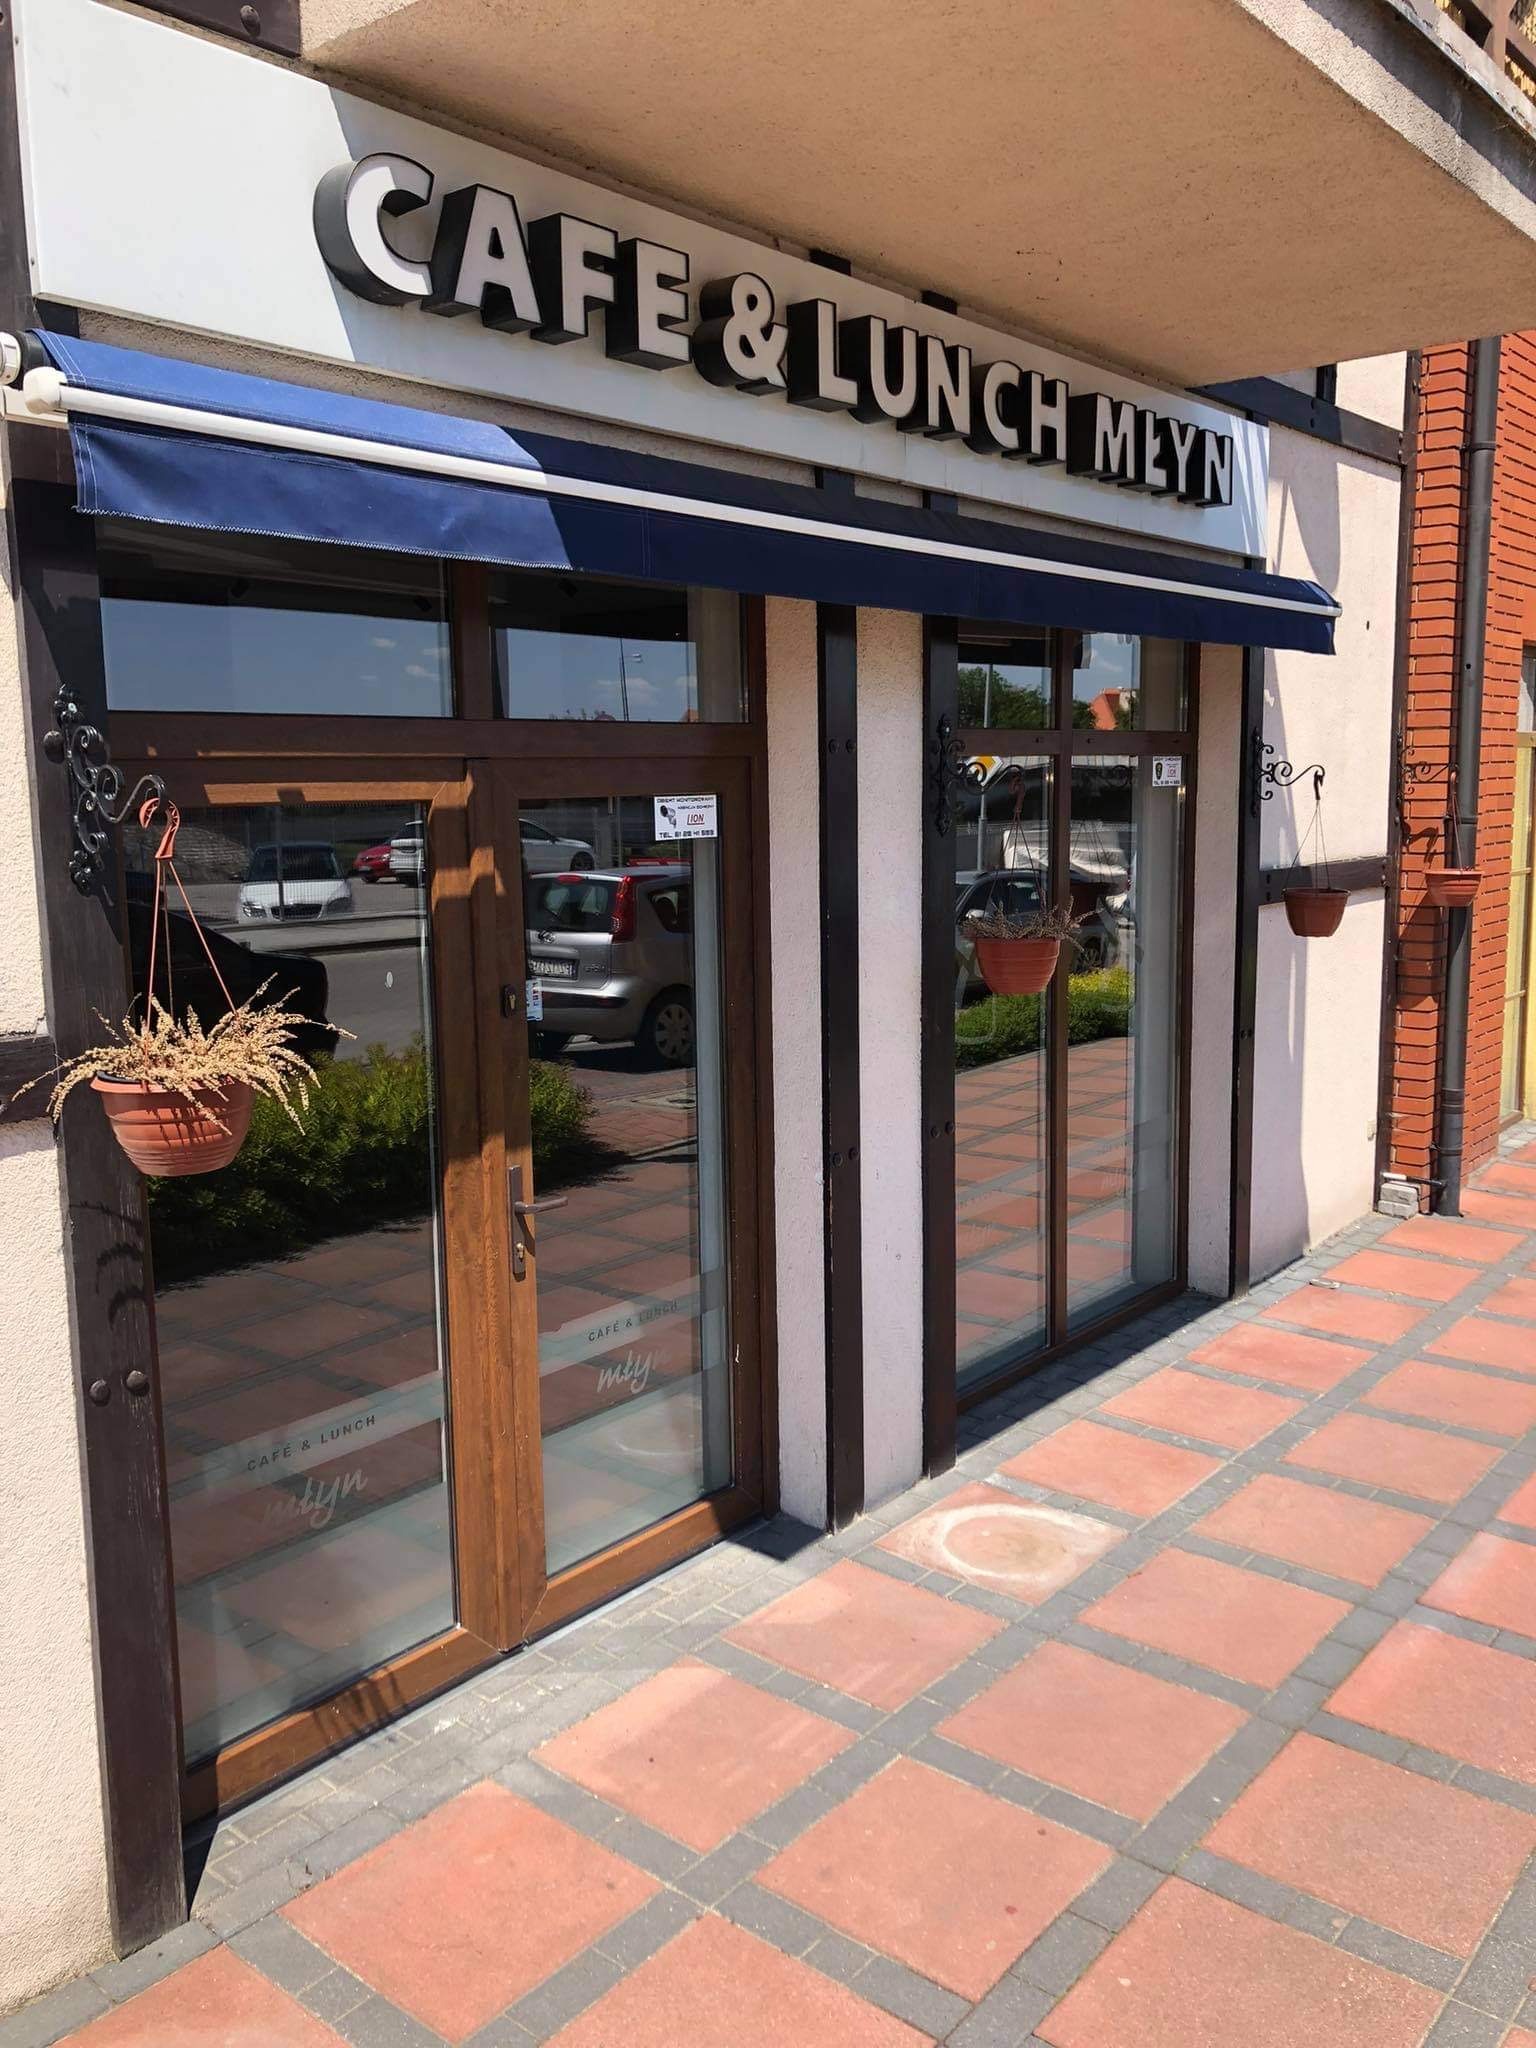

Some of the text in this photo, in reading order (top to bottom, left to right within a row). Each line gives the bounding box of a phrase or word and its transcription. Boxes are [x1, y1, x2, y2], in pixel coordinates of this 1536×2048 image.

[316, 152, 1233, 508] CAFE & LUNCH MŁYN
[687, 813, 705, 825] LION
[588, 1320, 620, 1342] CAFÉ
[247, 1415, 376, 1472] CAFÉ & LUNCH
